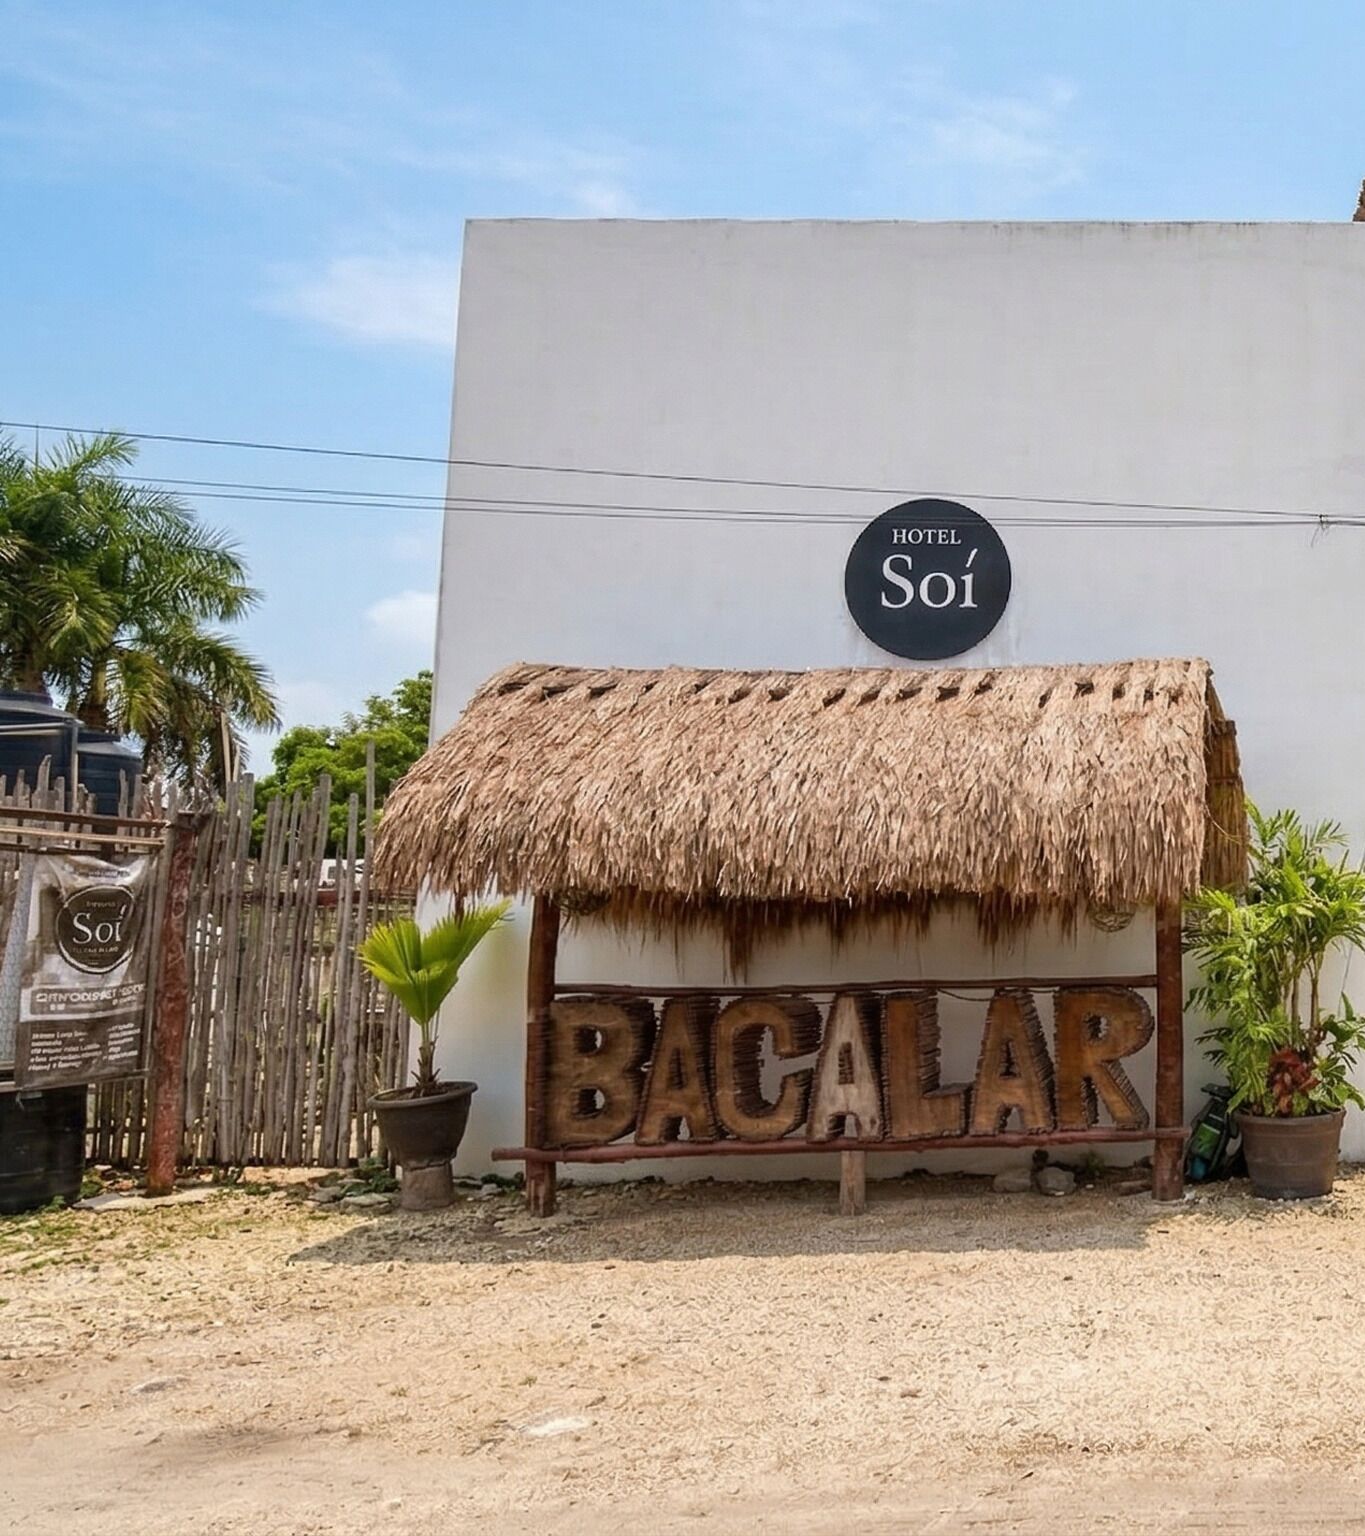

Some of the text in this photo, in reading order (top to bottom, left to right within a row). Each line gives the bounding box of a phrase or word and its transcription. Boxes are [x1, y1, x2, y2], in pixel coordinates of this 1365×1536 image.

[892, 528, 962, 545] HOTEL
[881, 547, 979, 609] Soí
[541, 986, 1155, 1147] BACALAR
